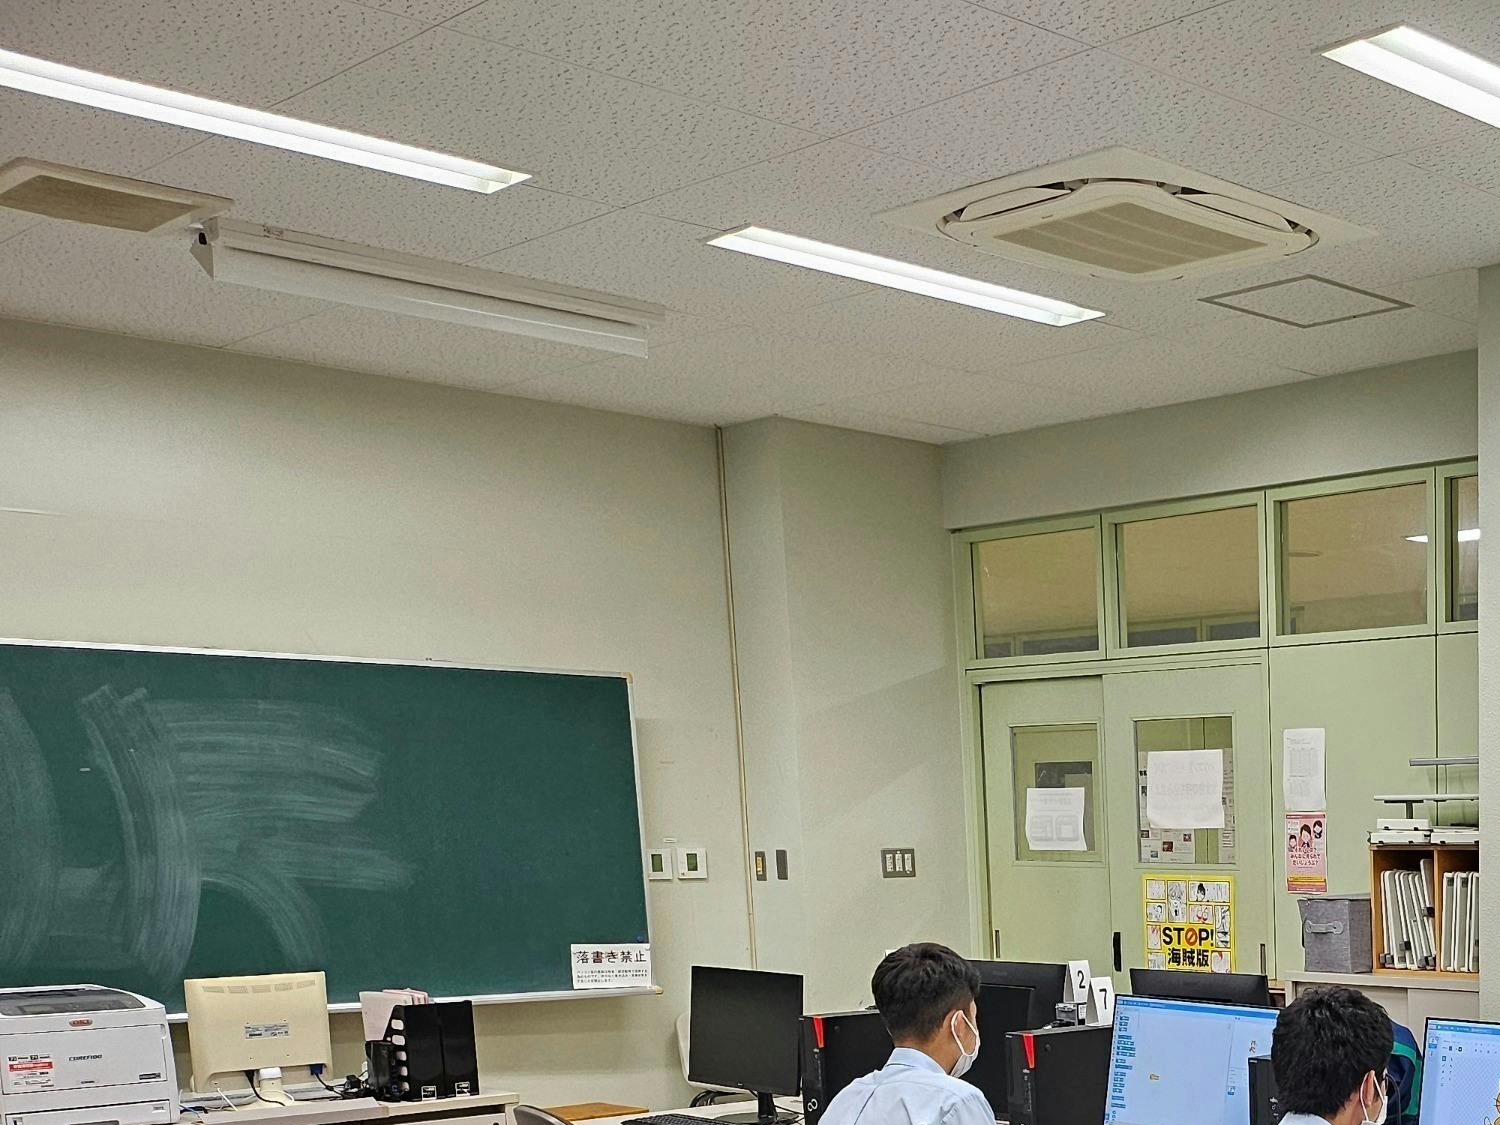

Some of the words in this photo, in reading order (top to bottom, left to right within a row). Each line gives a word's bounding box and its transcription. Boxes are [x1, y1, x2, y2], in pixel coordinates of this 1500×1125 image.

[1162, 926, 1214, 947] STOP!
[576, 949, 647, 964] 落書き禁止
[1167, 947, 1210, 967] 海賊版
[1077, 970, 1086, 989] 2
[1098, 988, 1108, 1010] 7
